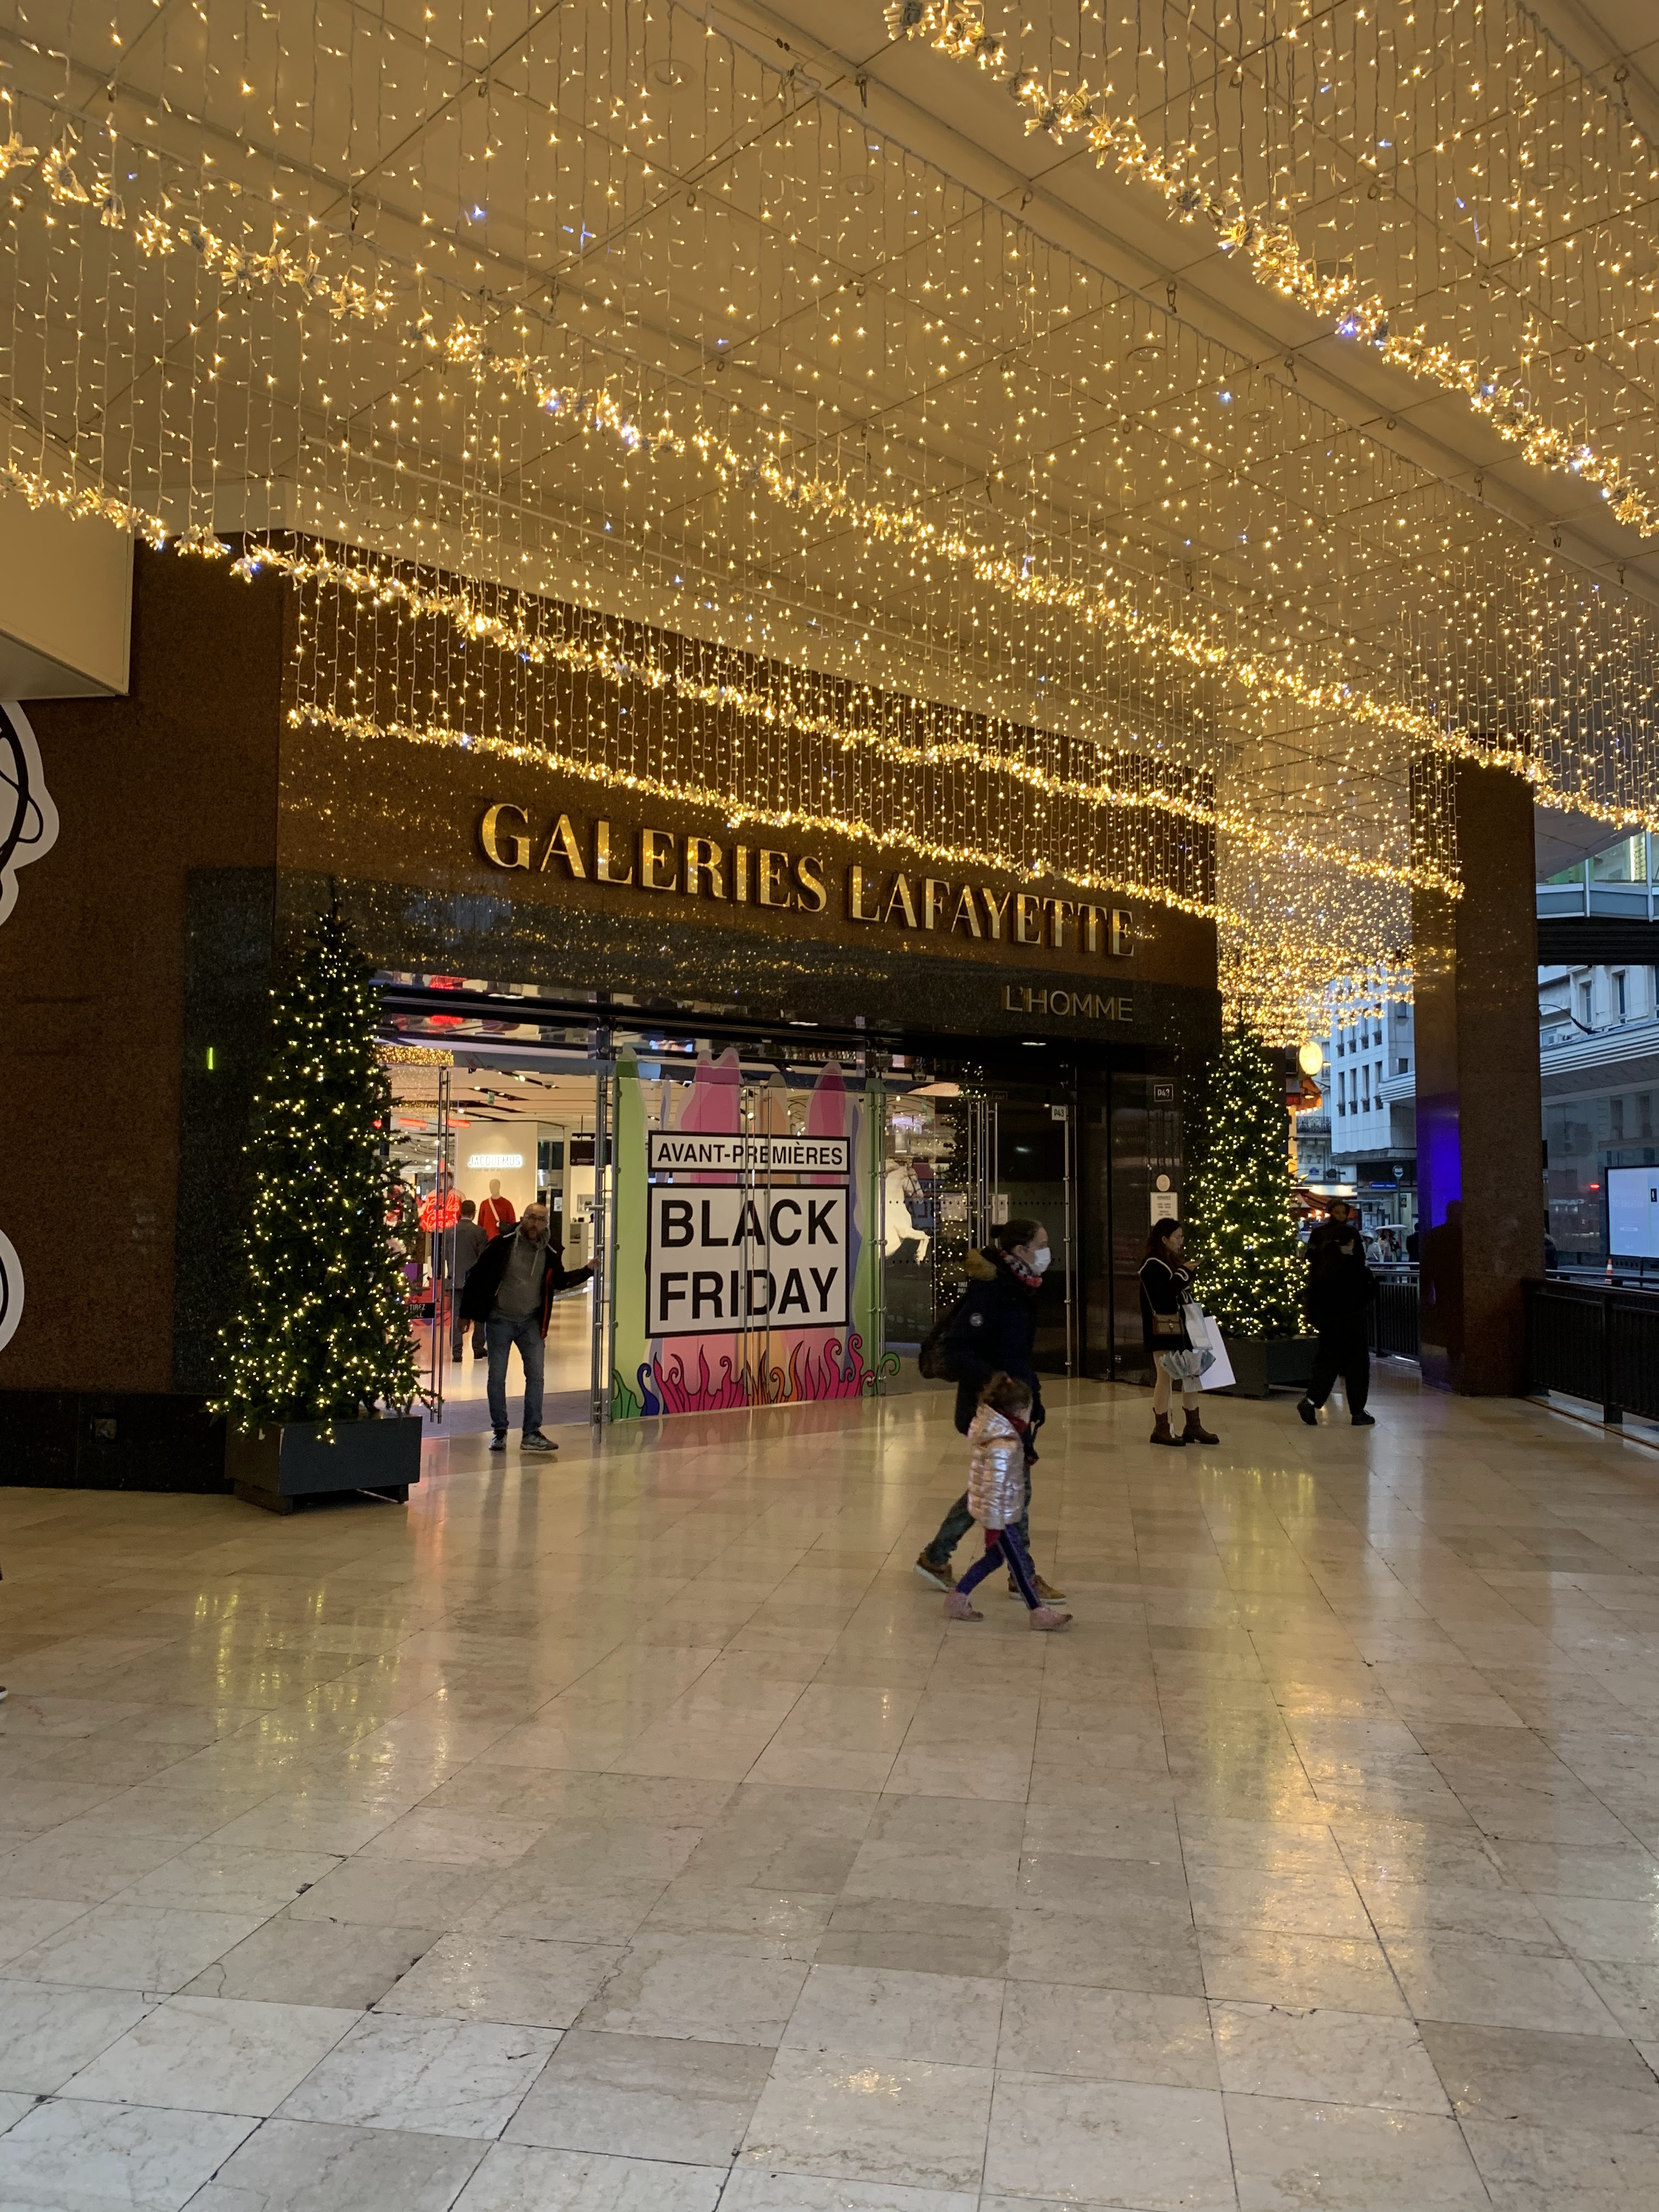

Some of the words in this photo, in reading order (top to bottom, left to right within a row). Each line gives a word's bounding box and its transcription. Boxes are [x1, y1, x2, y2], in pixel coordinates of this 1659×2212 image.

[479, 803, 827, 913] GALERIES
[848, 865, 1135, 957] LAFAYETTE
[1003, 985, 1133, 1022] L'HOMME
[469, 1156, 521, 1166] JACQUEMUS
[658, 1141, 843, 1166] AVANT-PREMIÈRES
[660, 1198, 838, 1248] BLACK
[659, 1267, 839, 1321] FRIDAY
